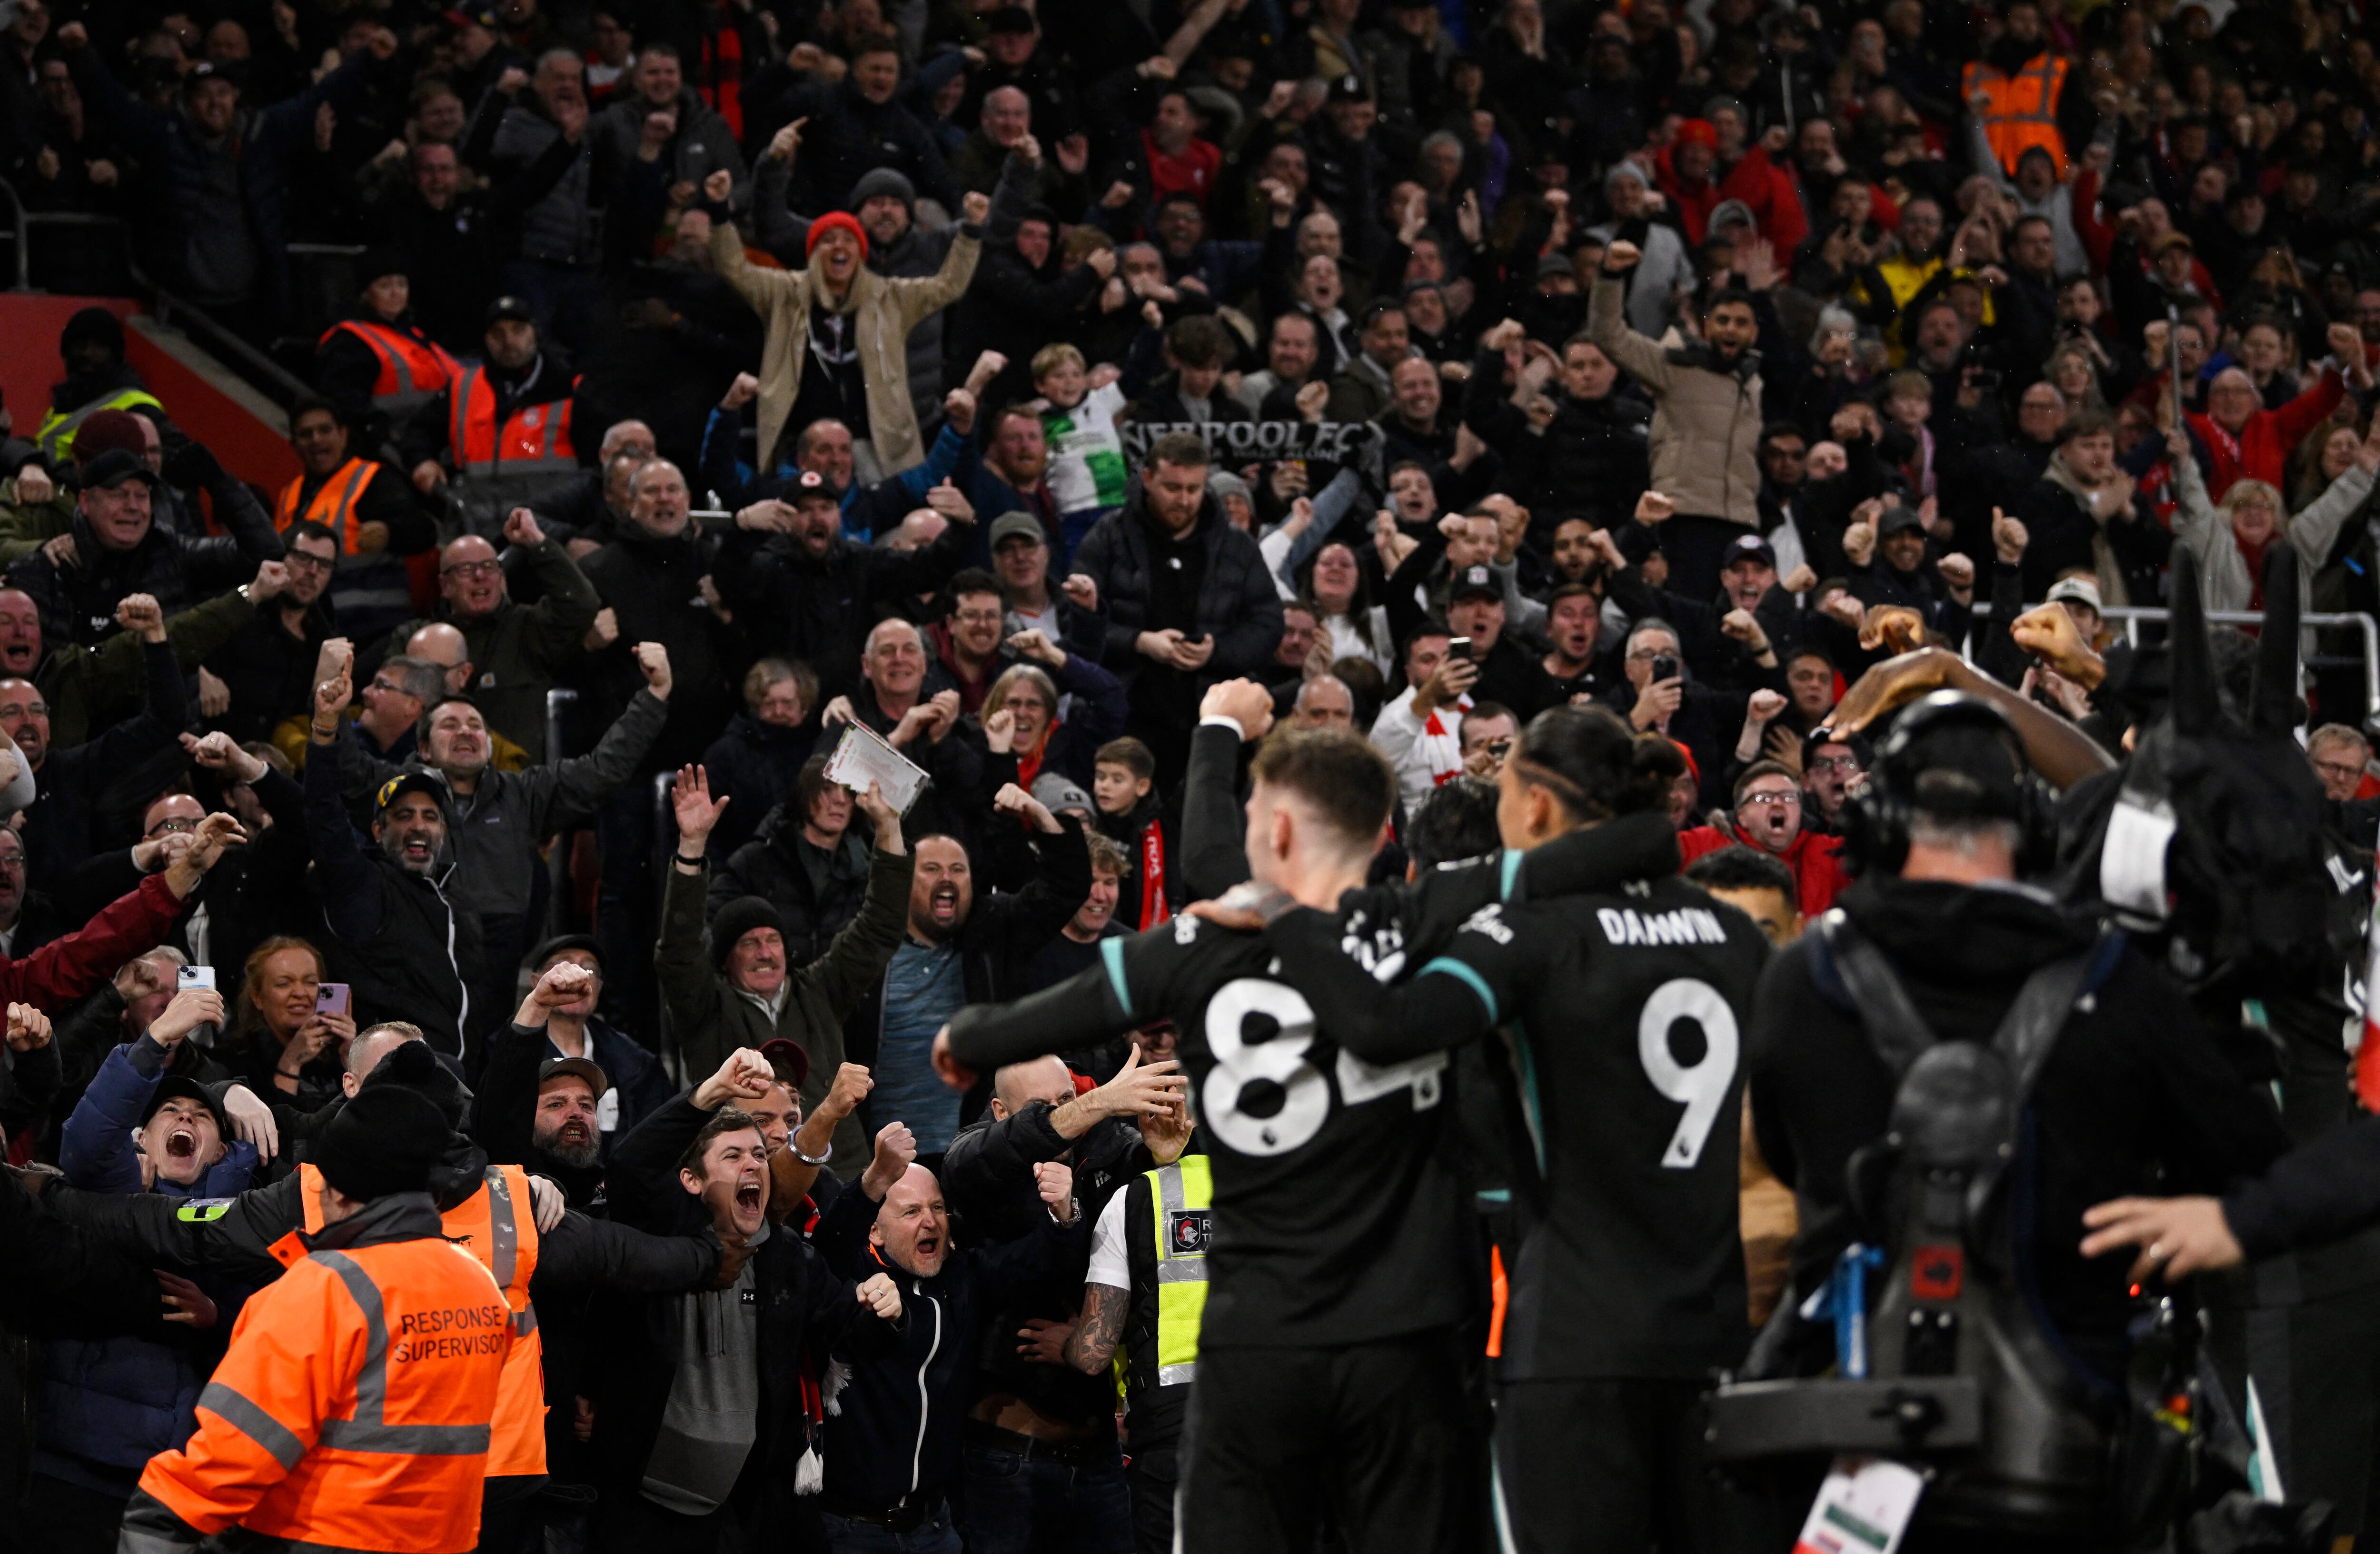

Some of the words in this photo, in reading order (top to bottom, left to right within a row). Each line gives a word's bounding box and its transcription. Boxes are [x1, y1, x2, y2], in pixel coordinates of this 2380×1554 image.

[1310, 421, 1365, 451] FC
[1637, 976, 1740, 1169] 9
[401, 1305, 502, 1334] RESPONSE
